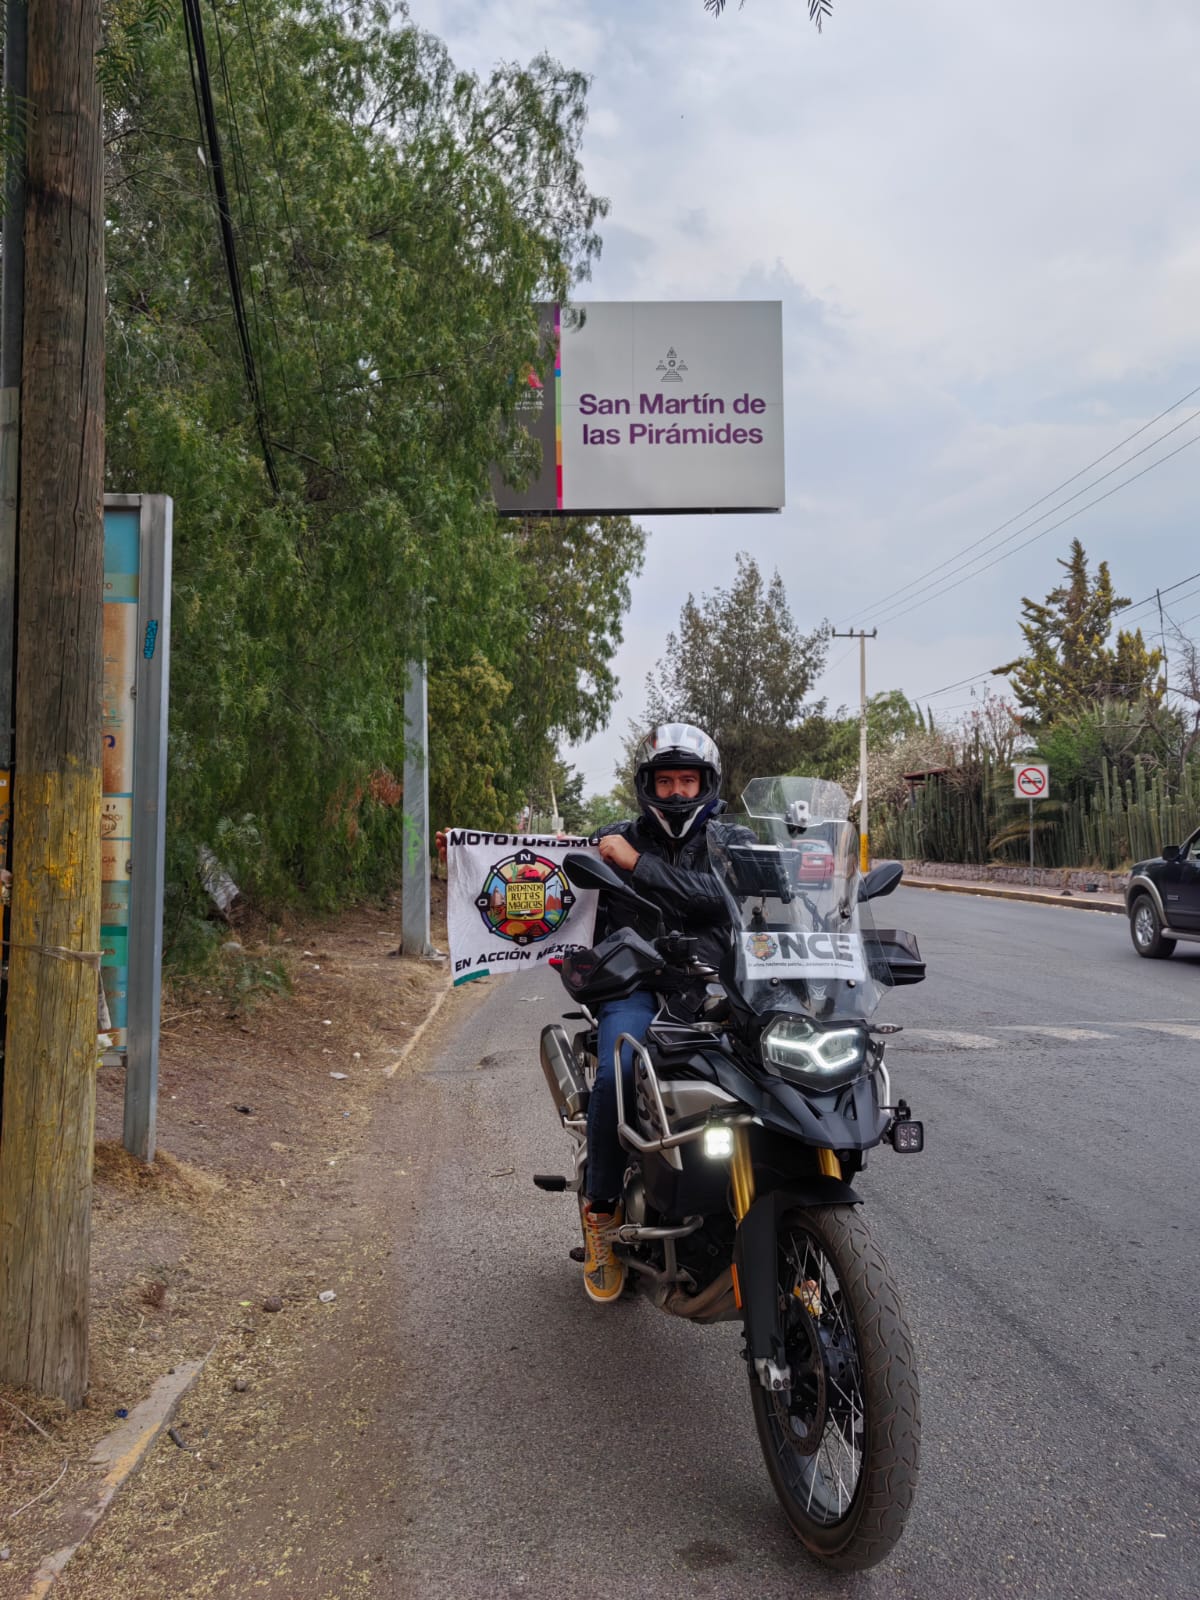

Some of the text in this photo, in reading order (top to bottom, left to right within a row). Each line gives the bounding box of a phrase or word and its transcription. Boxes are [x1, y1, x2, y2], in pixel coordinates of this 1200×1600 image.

[579, 393, 766, 415] San Martín de
[583, 423, 763, 445] las Pirámides
[520, 853, 531, 861] N
[563, 896, 572, 904] E
[455, 958, 471, 972] EN
[476, 948, 531, 965] ACCIÓN
